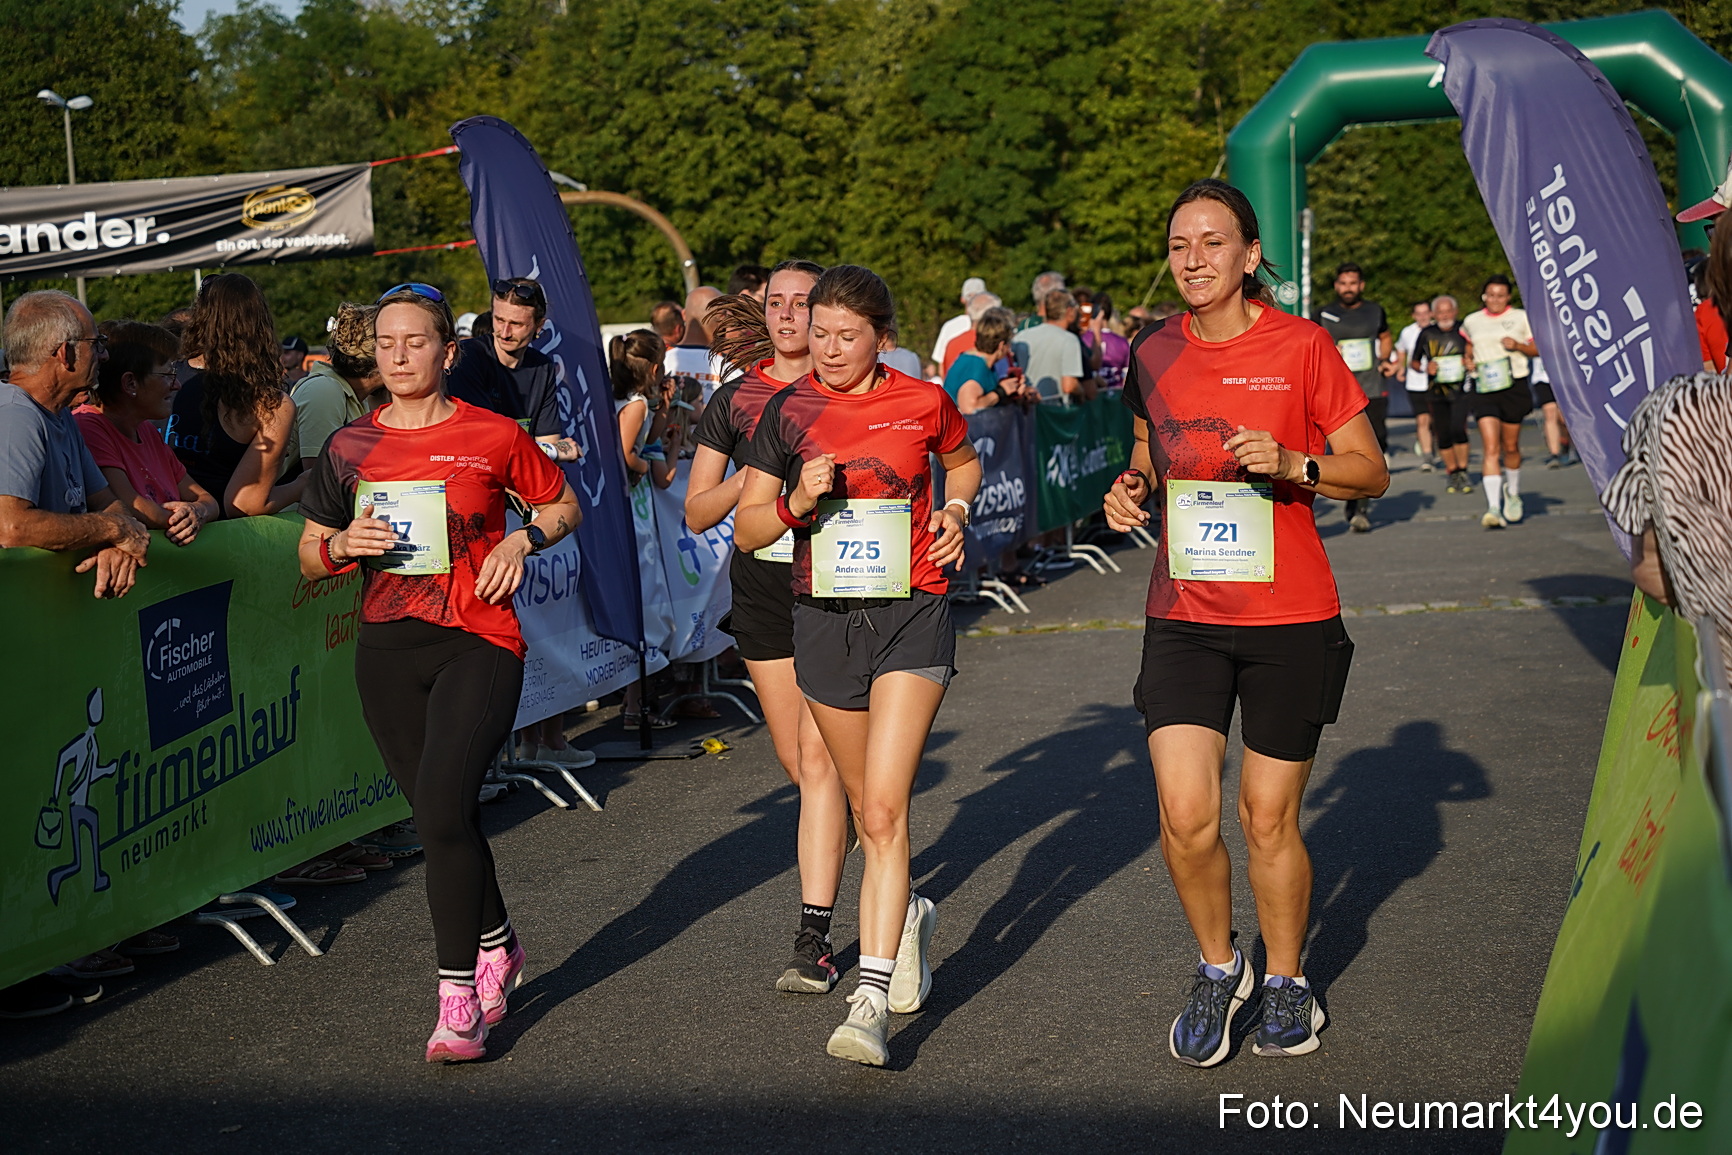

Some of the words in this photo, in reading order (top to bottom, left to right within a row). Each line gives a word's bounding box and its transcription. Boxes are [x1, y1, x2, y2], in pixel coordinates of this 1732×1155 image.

[216, 239, 236, 253] Ein
[237, 238, 261, 251] Ort,
[262, 236, 284, 248] der
[285, 233, 349, 247] verbindet.
[1222, 377, 1247, 385] DISTLER
[1261, 383, 1292, 391] INGENIEURE
[430, 454, 455, 462] DISTLER
[1198, 522, 1238, 542] 721
[409, 543, 431, 552] März
[836, 541, 881, 560] 725
[1185, 547, 1217, 557] Marina
[1218, 548, 1257, 557] Sendner
[835, 565, 865, 574] Andrea
[866, 565, 886, 574] Wild
[160, 630, 215, 671] Fischer
[580, 638, 611, 661] HEUTE
[167, 654, 213, 684] AUTOMOBILE
[114, 664, 301, 837] firmenlauf
[121, 799, 208, 873] neumarkt
